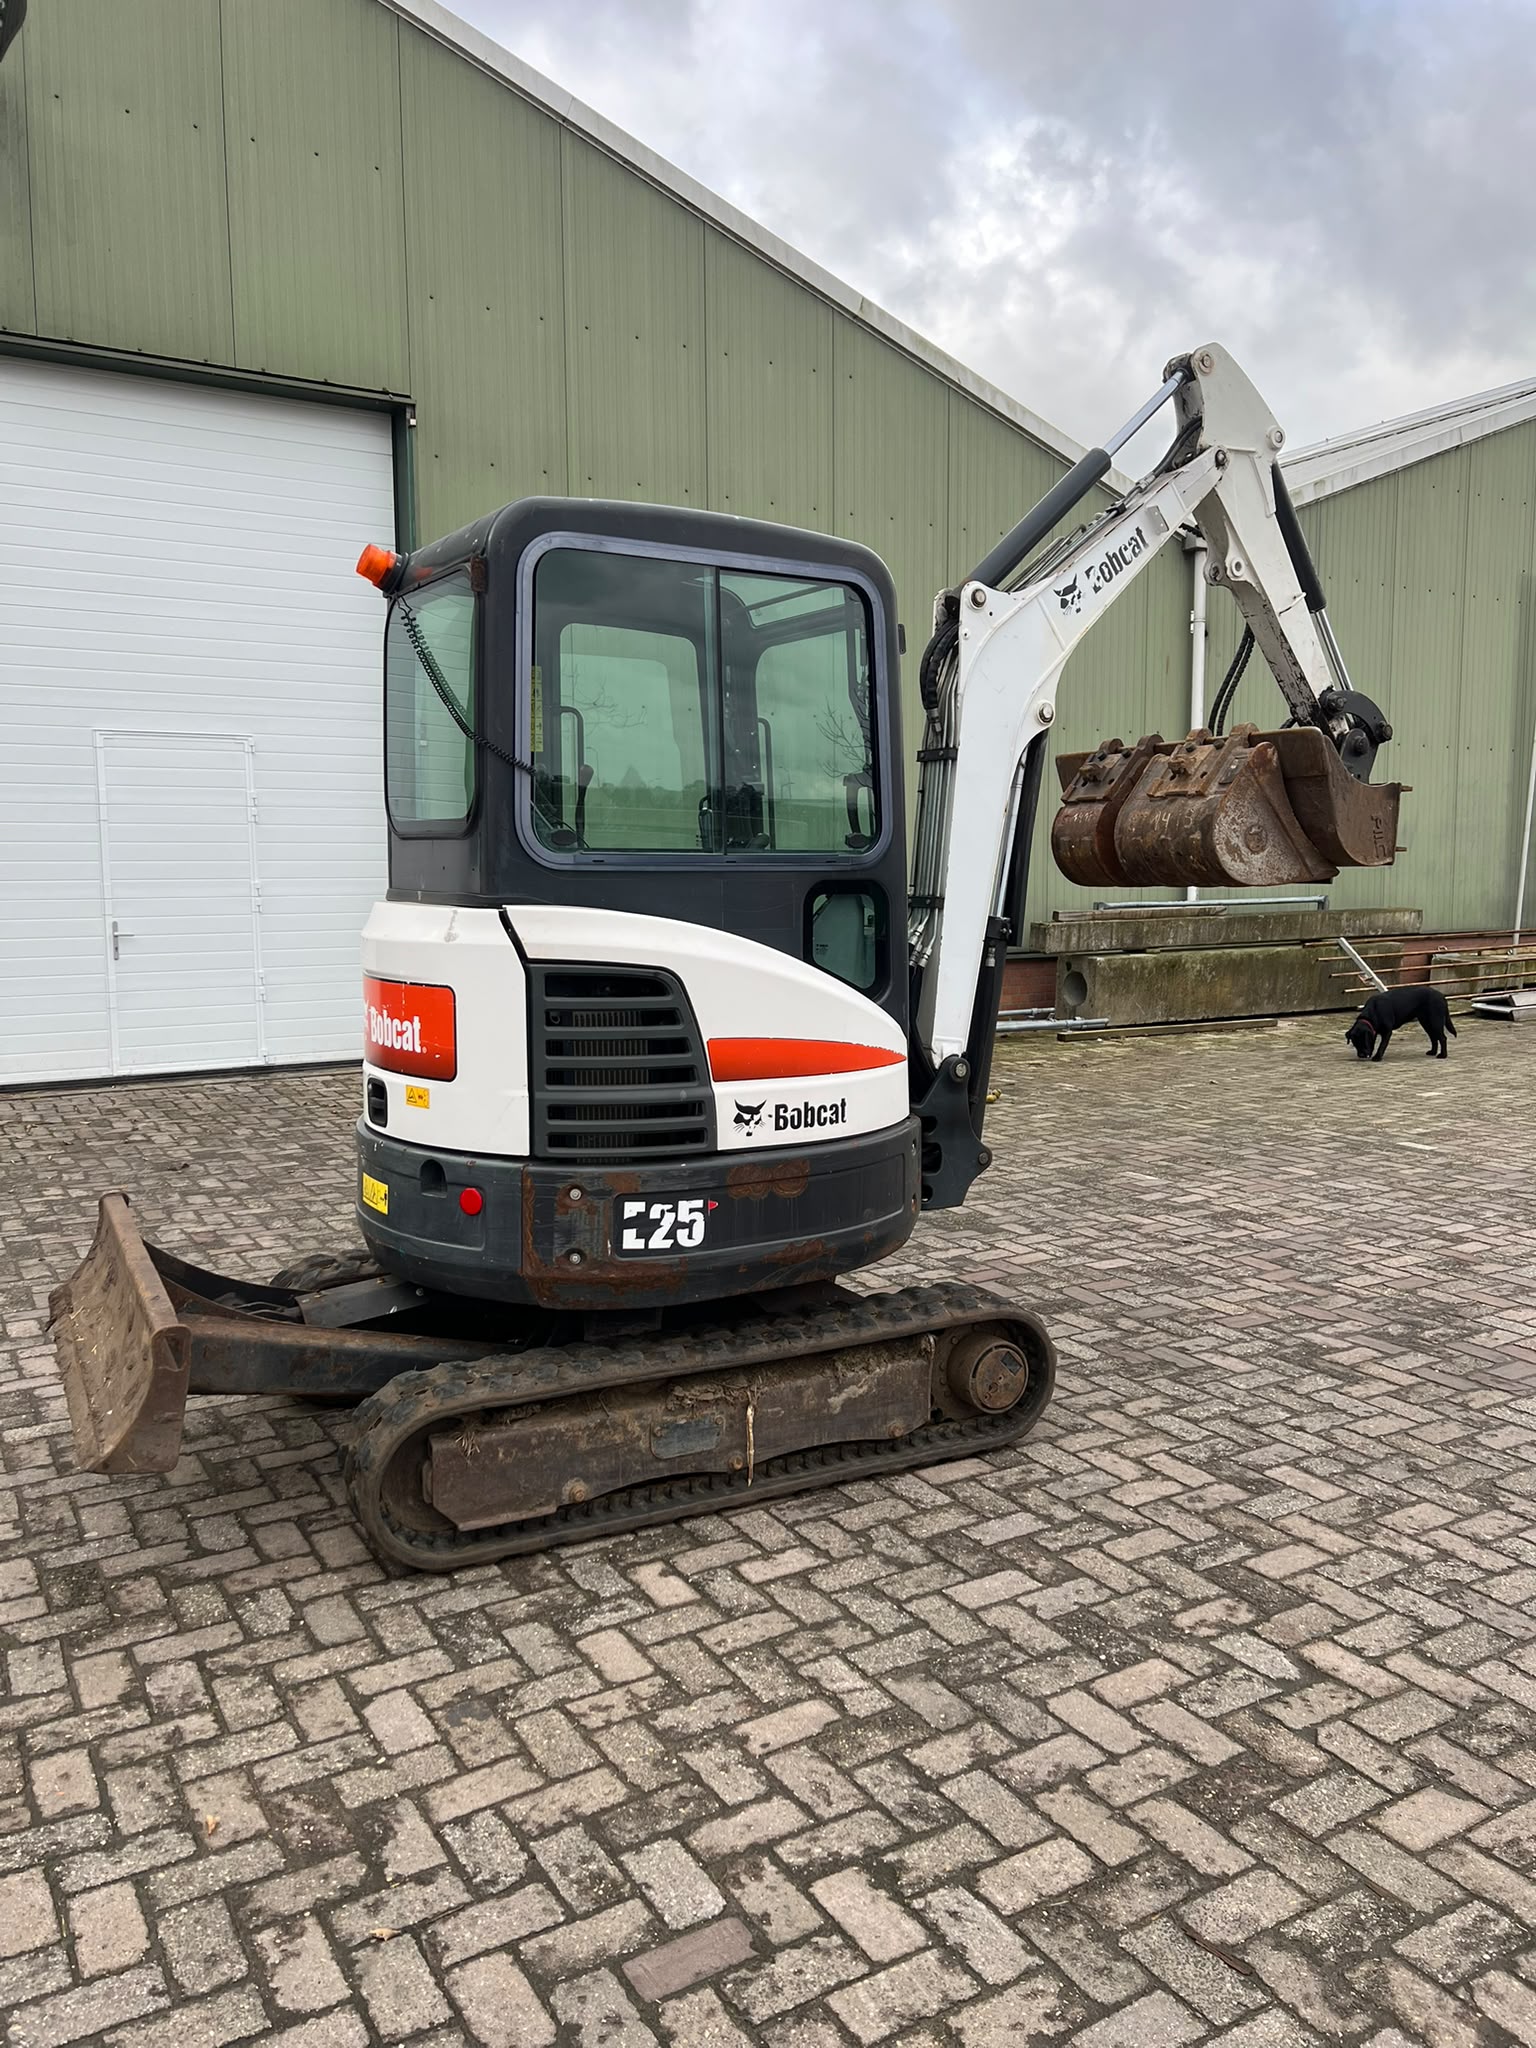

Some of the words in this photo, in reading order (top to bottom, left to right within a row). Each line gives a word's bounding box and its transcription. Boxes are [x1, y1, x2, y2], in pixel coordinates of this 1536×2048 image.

[370, 1006, 421, 1053] Bobcat
[774, 1098, 847, 1131] Bobcat
[622, 1199, 705, 1250] E25
